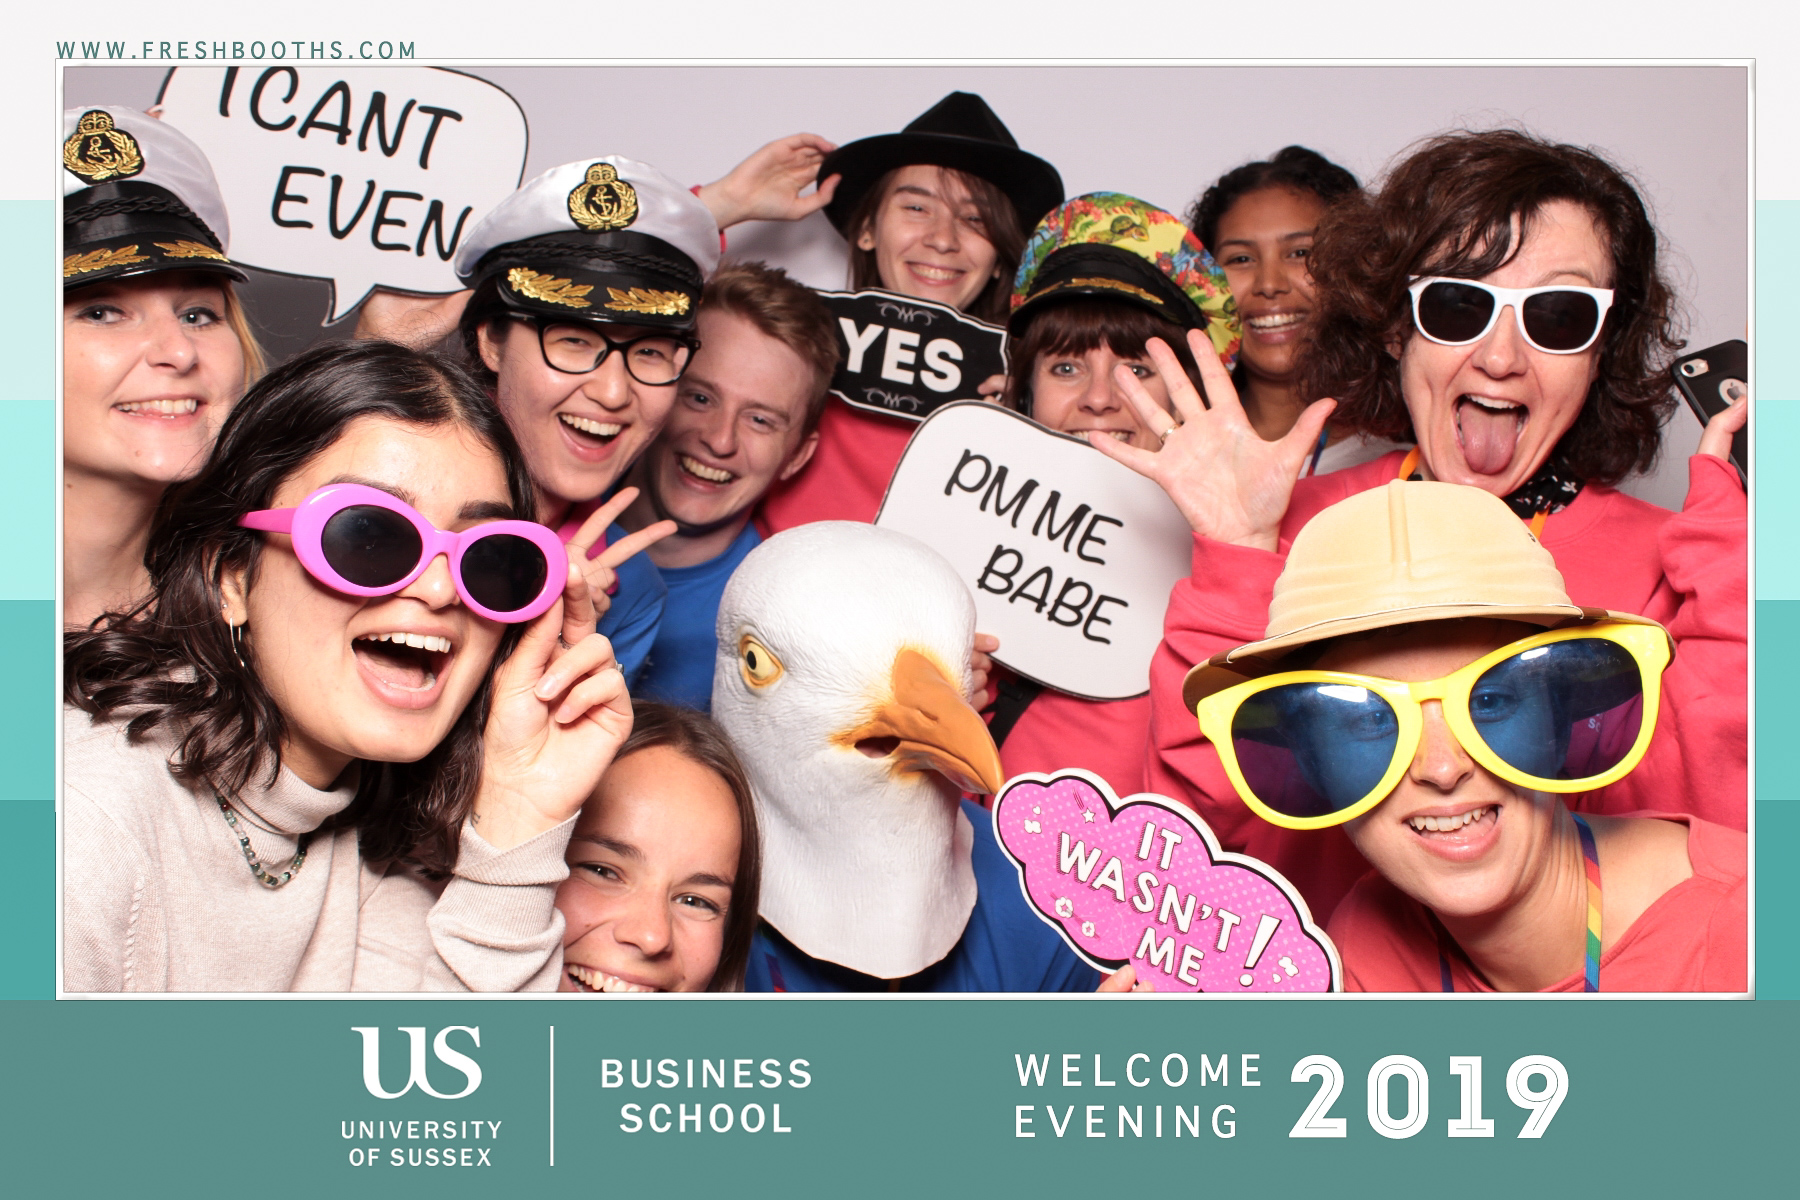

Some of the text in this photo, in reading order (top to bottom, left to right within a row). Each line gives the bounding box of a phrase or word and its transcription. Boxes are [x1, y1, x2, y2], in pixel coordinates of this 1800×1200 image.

[250, 66, 463, 170] CANT
[271, 165, 473, 262] EVEN
[838, 317, 964, 393] YES
[944, 449, 1123, 566] PM ME
[977, 544, 1129, 645] BABE
[1058, 831, 1242, 953] WASN'T
[1136, 820, 1183, 871] IT
